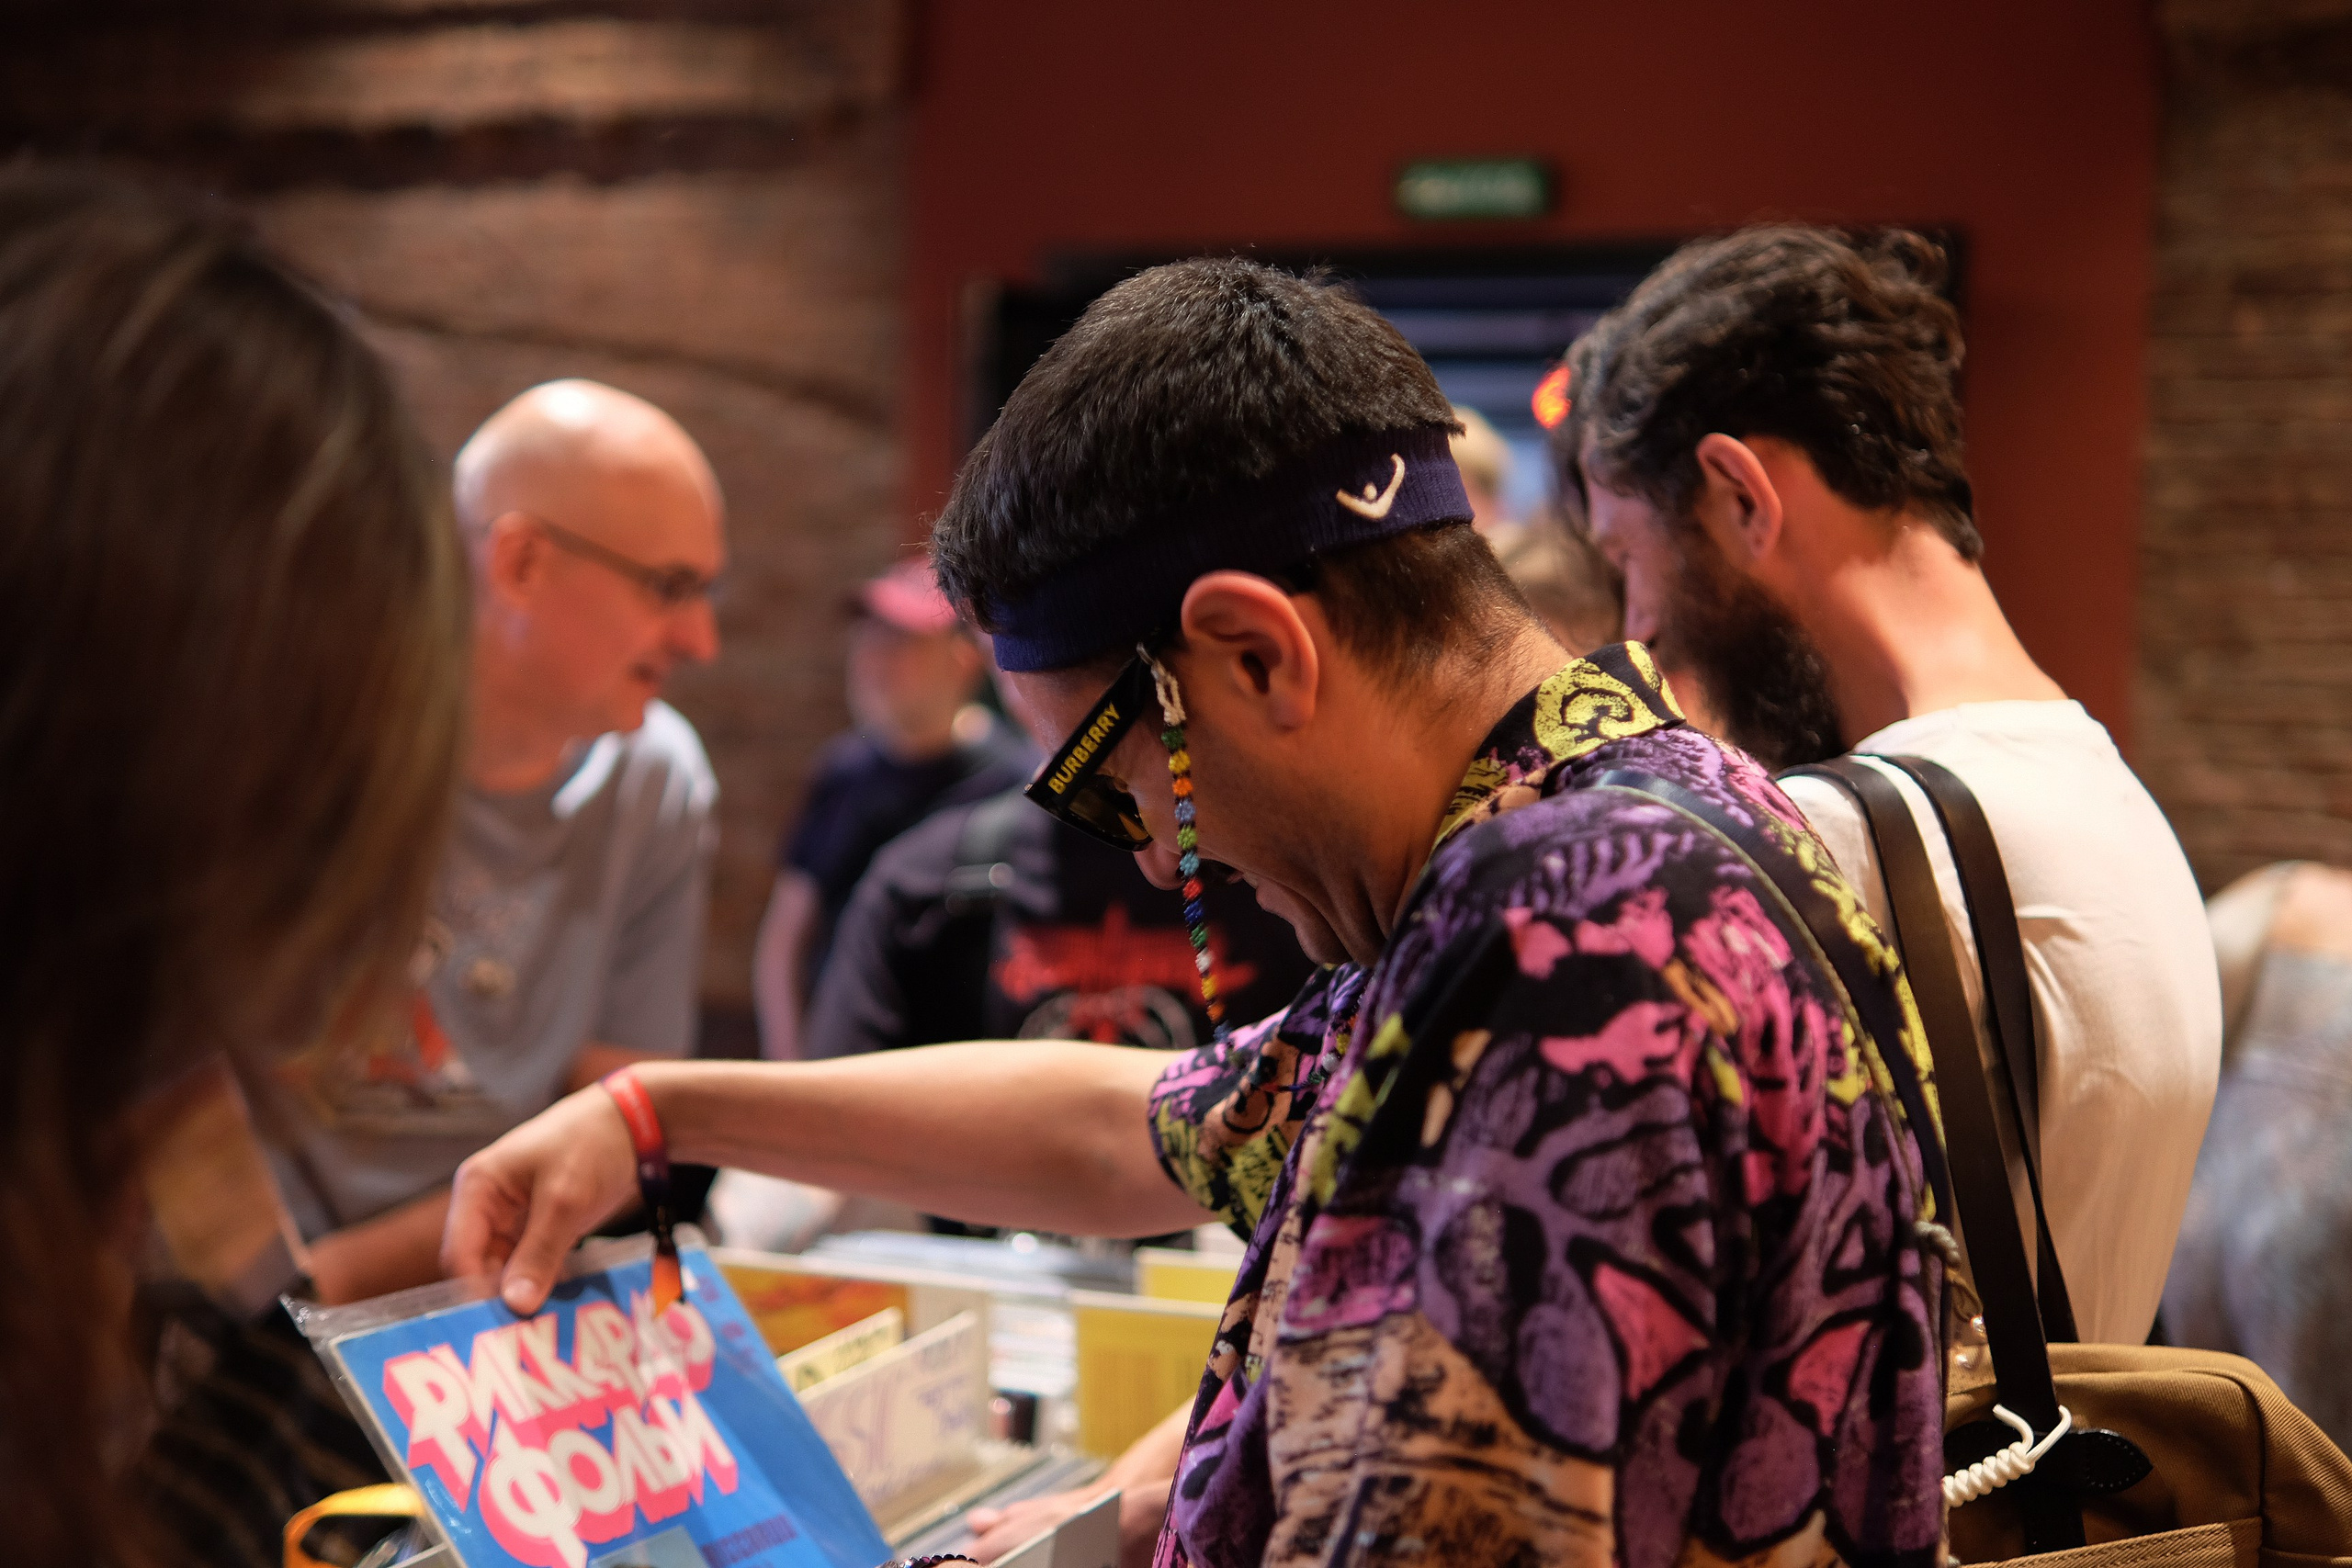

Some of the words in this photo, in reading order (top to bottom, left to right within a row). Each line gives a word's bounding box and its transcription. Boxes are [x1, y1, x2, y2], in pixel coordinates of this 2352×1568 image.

[1047, 702, 1121, 795] BURBERRY
[383, 1288, 717, 1509] РИККАРДО
[479, 1391, 739, 1568] ФОЛЬИ
